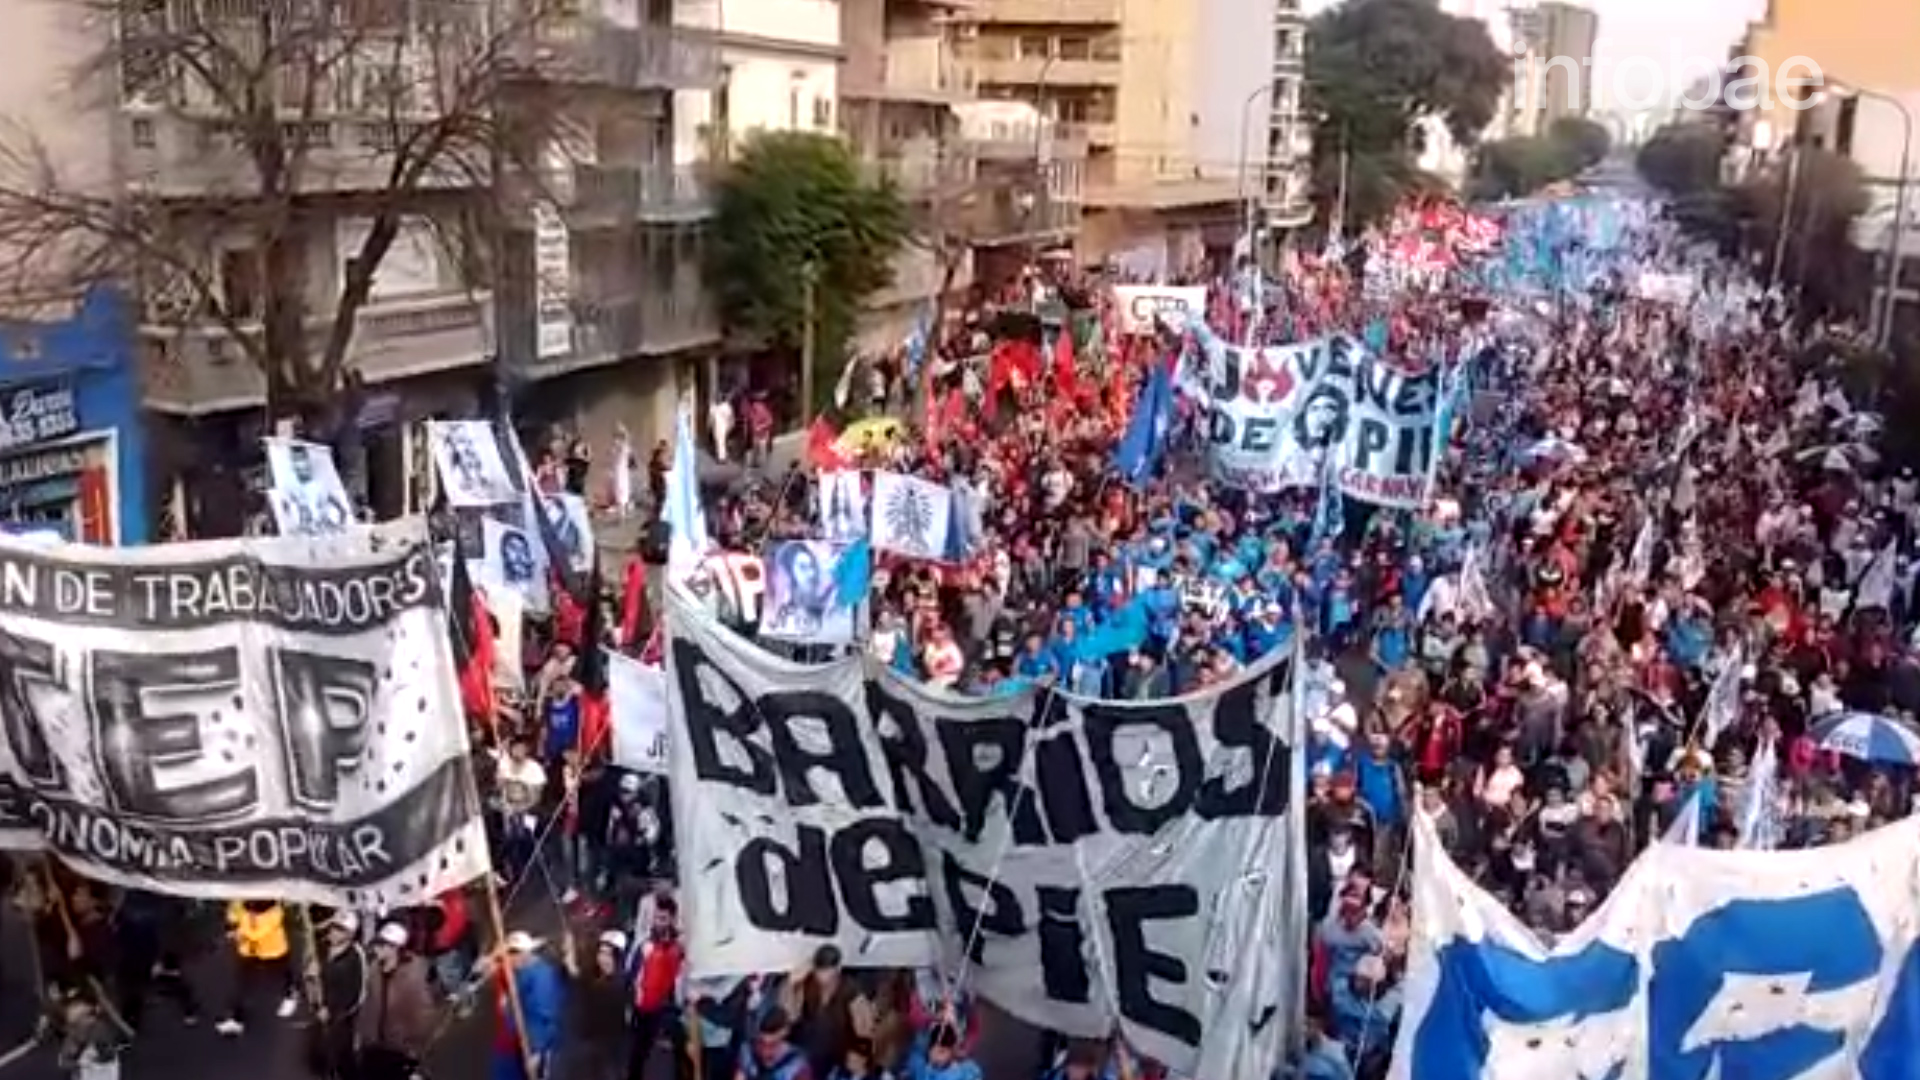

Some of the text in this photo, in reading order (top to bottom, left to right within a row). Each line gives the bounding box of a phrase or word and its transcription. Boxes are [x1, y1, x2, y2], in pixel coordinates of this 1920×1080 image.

[1210, 408, 1276, 452] DE
[55, 571, 114, 616] DE
[735, 816, 937, 937] de
